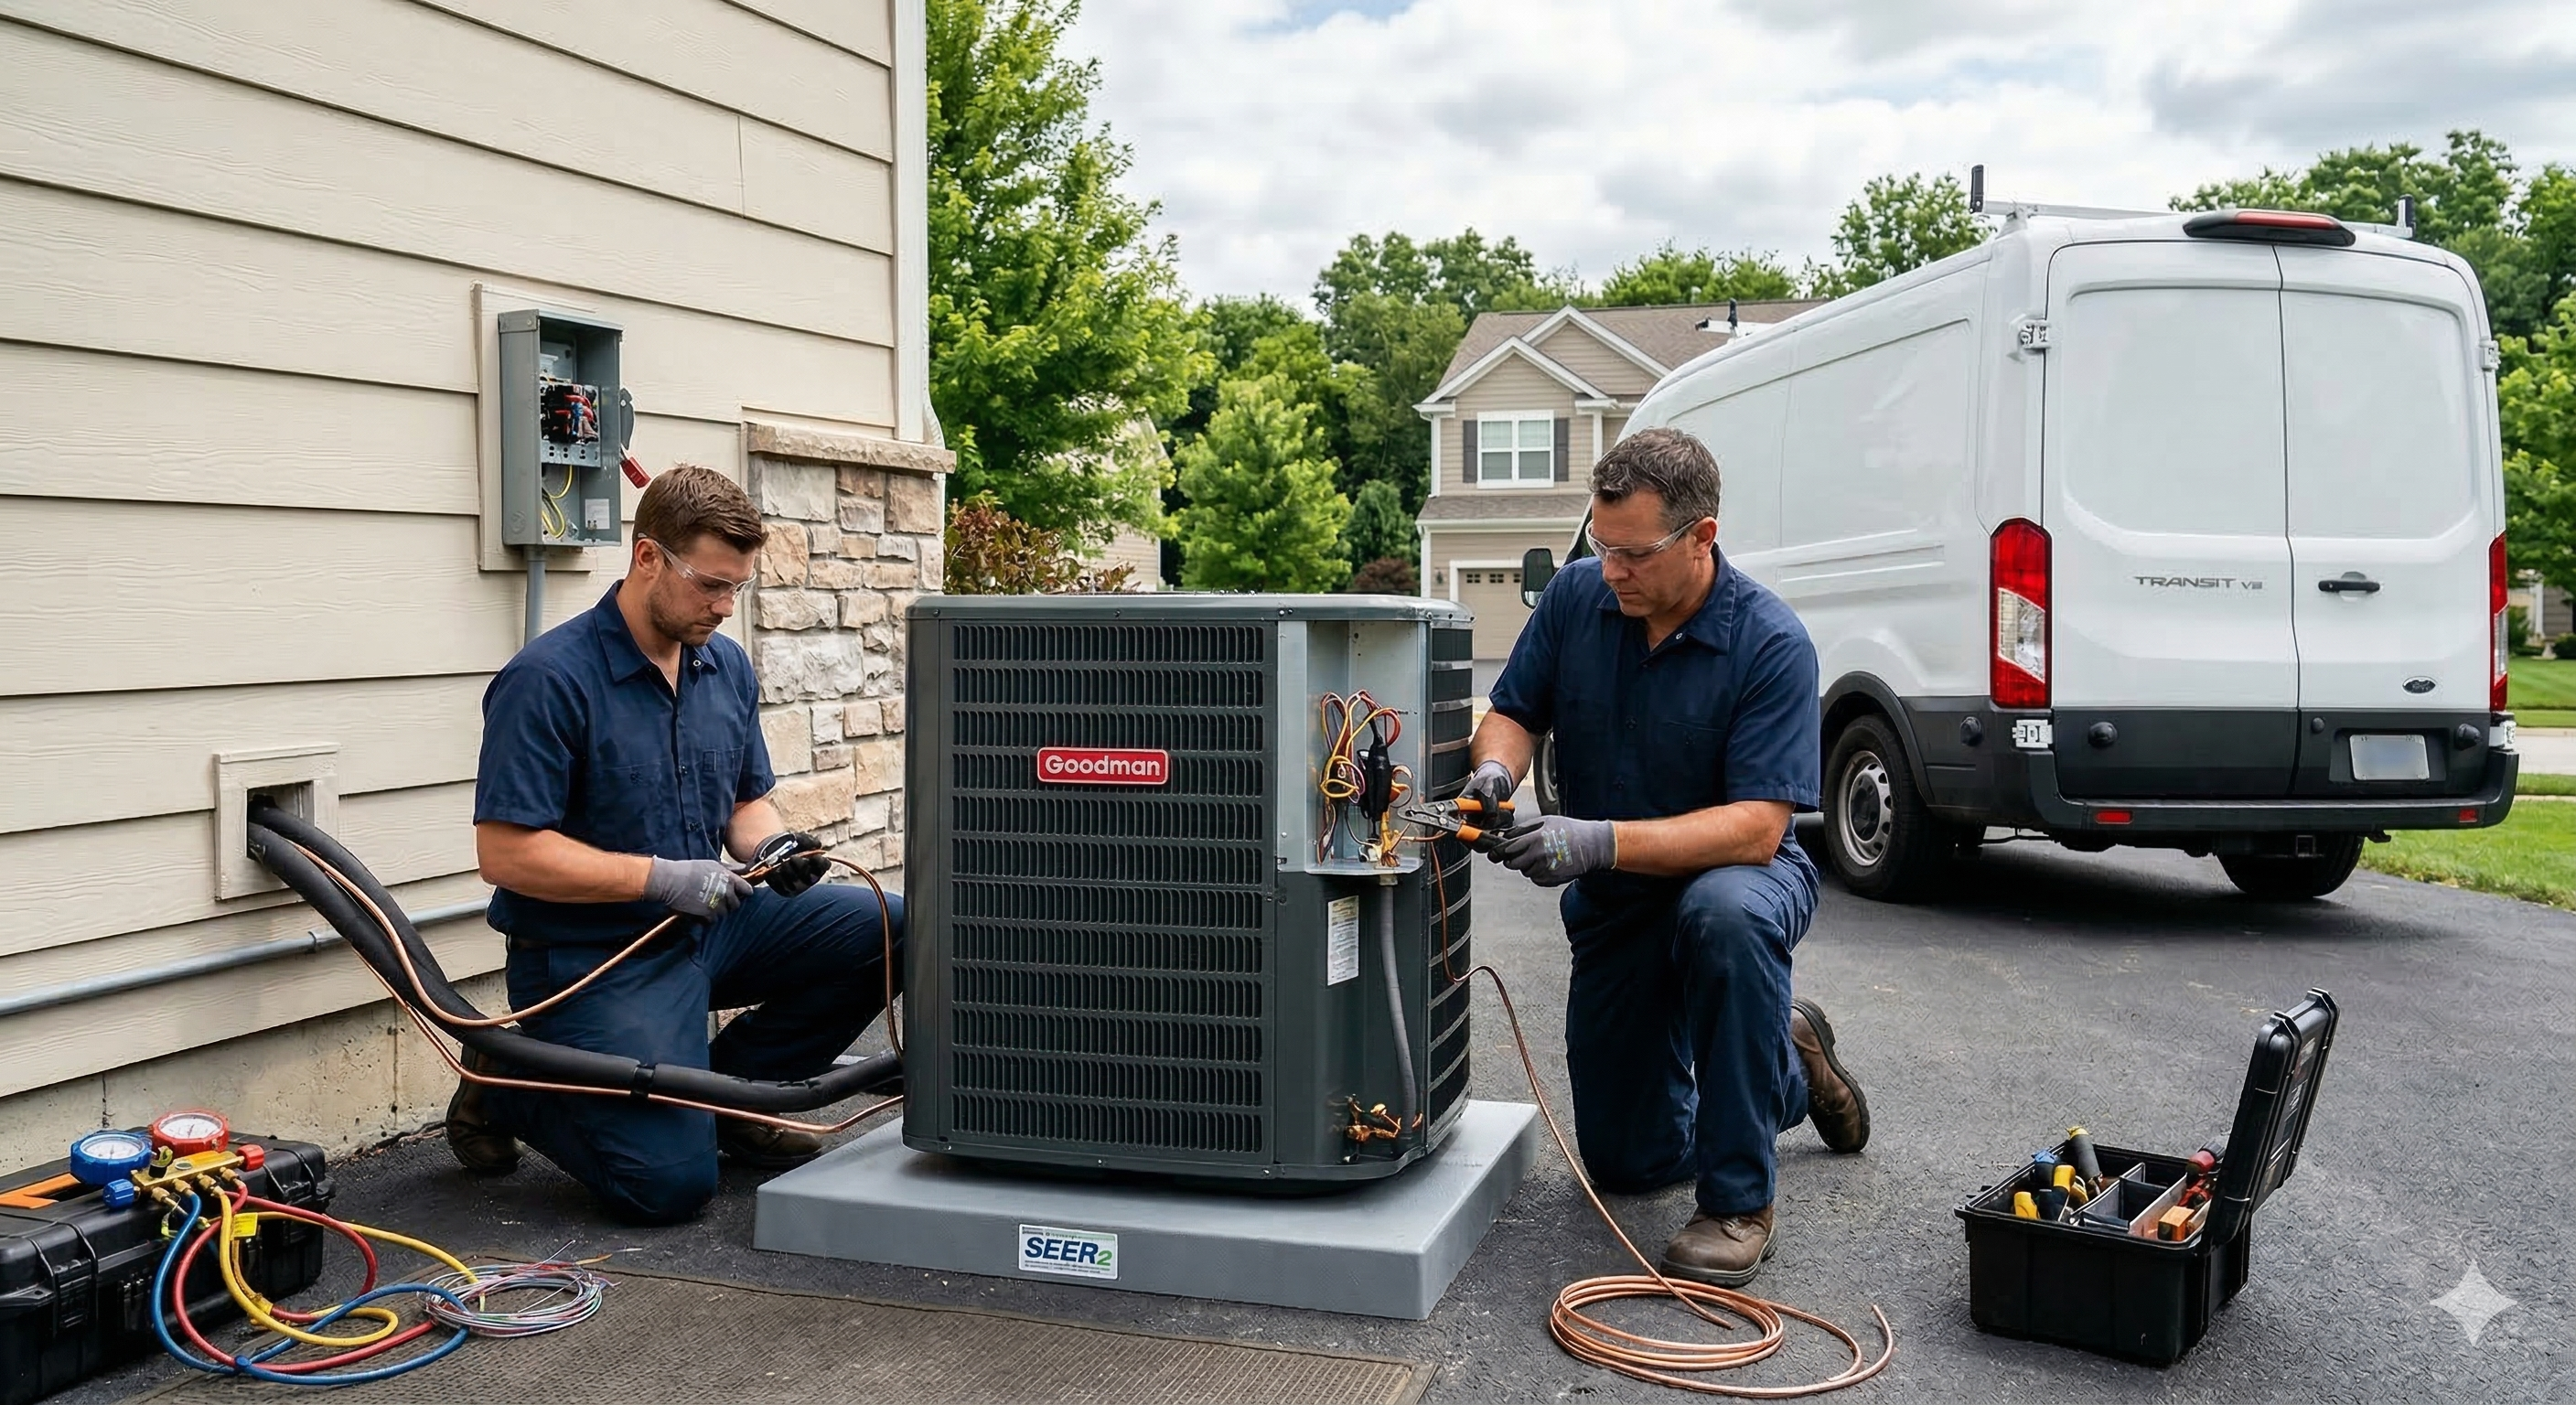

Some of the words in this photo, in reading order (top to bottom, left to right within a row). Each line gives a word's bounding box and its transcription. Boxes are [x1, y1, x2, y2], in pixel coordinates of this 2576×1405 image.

[2134, 576, 2236, 588] TRANSIT
[1045, 755, 1161, 777] Goodman
[1025, 1237, 1113, 1266] SEER2
